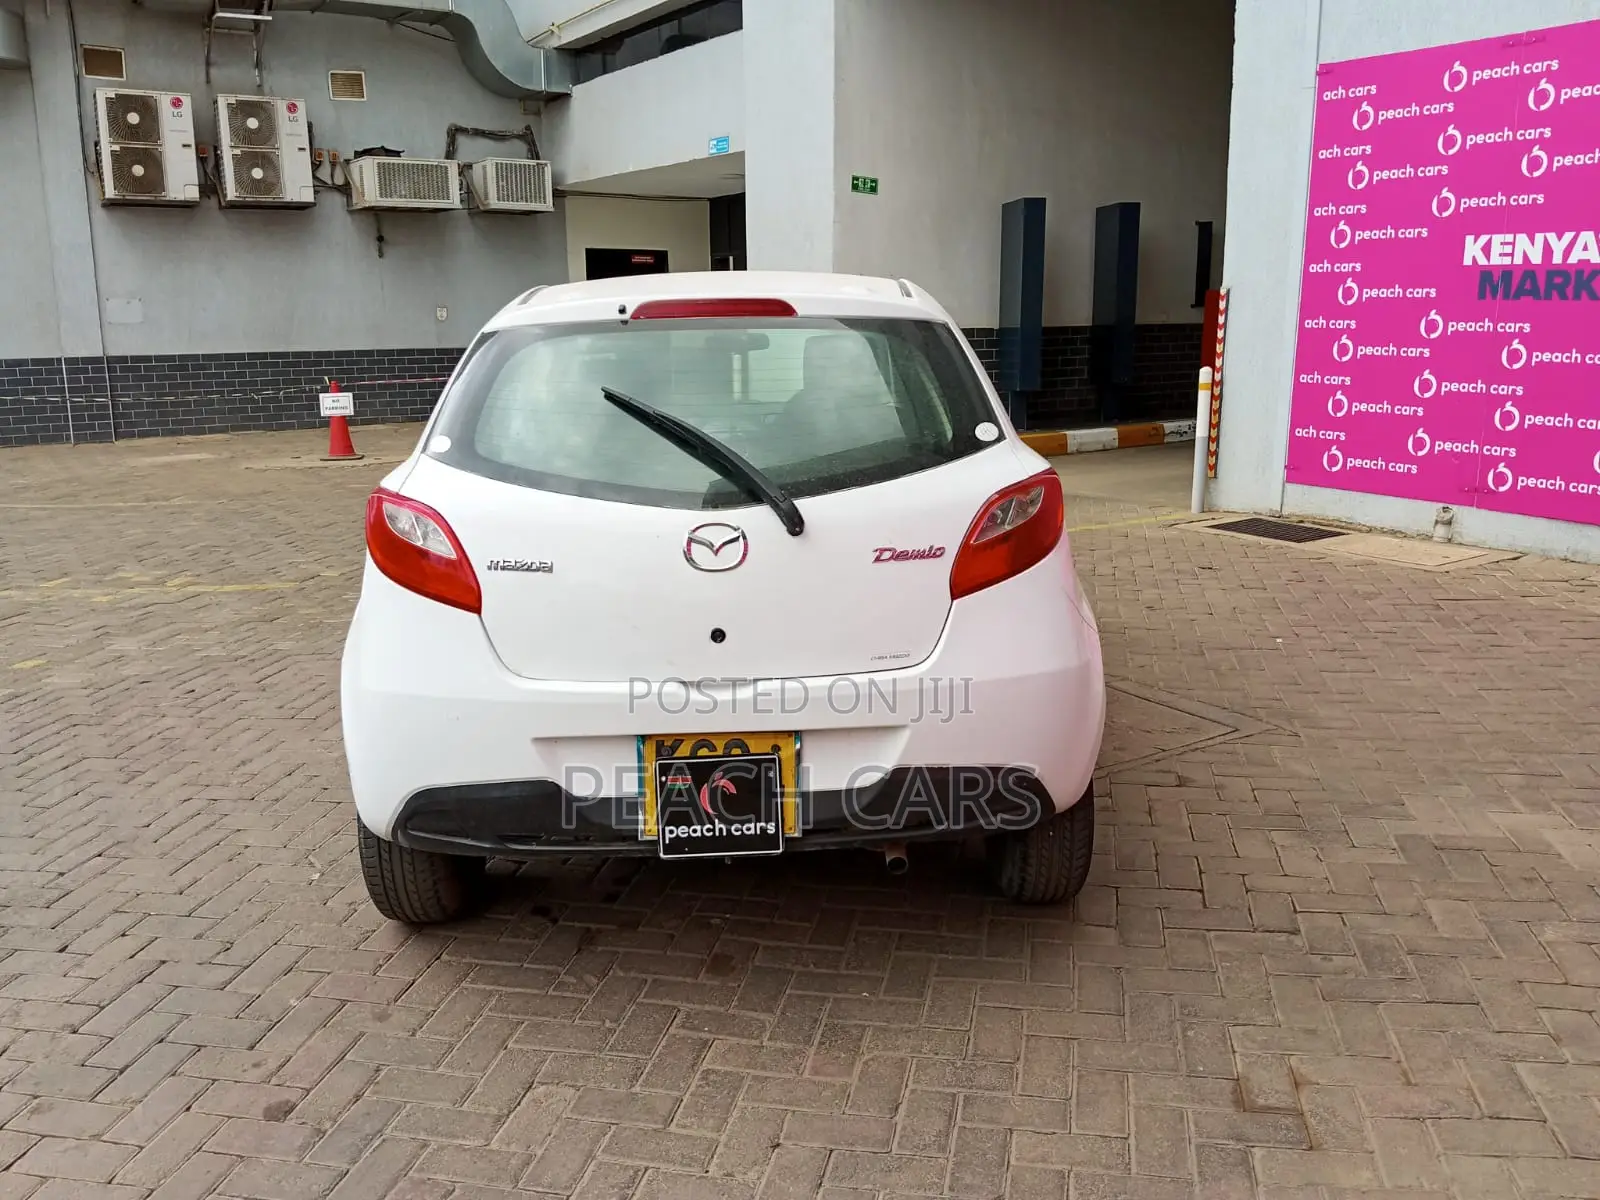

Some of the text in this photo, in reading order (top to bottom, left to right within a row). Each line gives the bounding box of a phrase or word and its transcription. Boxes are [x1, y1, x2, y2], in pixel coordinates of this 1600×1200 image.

[1471, 59, 1560, 86] peach cars
[1322, 84, 1377, 101] ach cars
[1559, 83, 1600, 105] peac
[288, 115, 298, 123] LG
[1377, 102, 1455, 125] peach cars
[1465, 126, 1552, 150] peach cars
[1318, 143, 1372, 160] ach cars
[1372, 163, 1449, 185] peach cars
[1313, 202, 1367, 217] ach cars
[1459, 191, 1545, 213] peach cars
[1354, 224, 1429, 245] peach cars
[1308, 259, 1362, 273] ach cars
[1362, 283, 1437, 303] peach cars
[1477, 269, 1600, 301] MARK
[1304, 315, 1357, 330] ach cars
[1447, 317, 1531, 336] peach cars
[1356, 342, 1431, 360] peach cars
[1531, 348, 1582, 367] peach
[1299, 370, 1352, 386] ach cars
[1440, 379, 1524, 396] peach cars
[1351, 400, 1424, 417] peach cars
[1524, 412, 1574, 429] peach
[1294, 425, 1346, 441] ach cars
[1434, 439, 1517, 458] peach cars
[1346, 456, 1419, 474] peach cars
[1516, 475, 1566, 491] peach
[872, 544, 946, 564] Demio
[664, 818, 777, 844] peach cars
